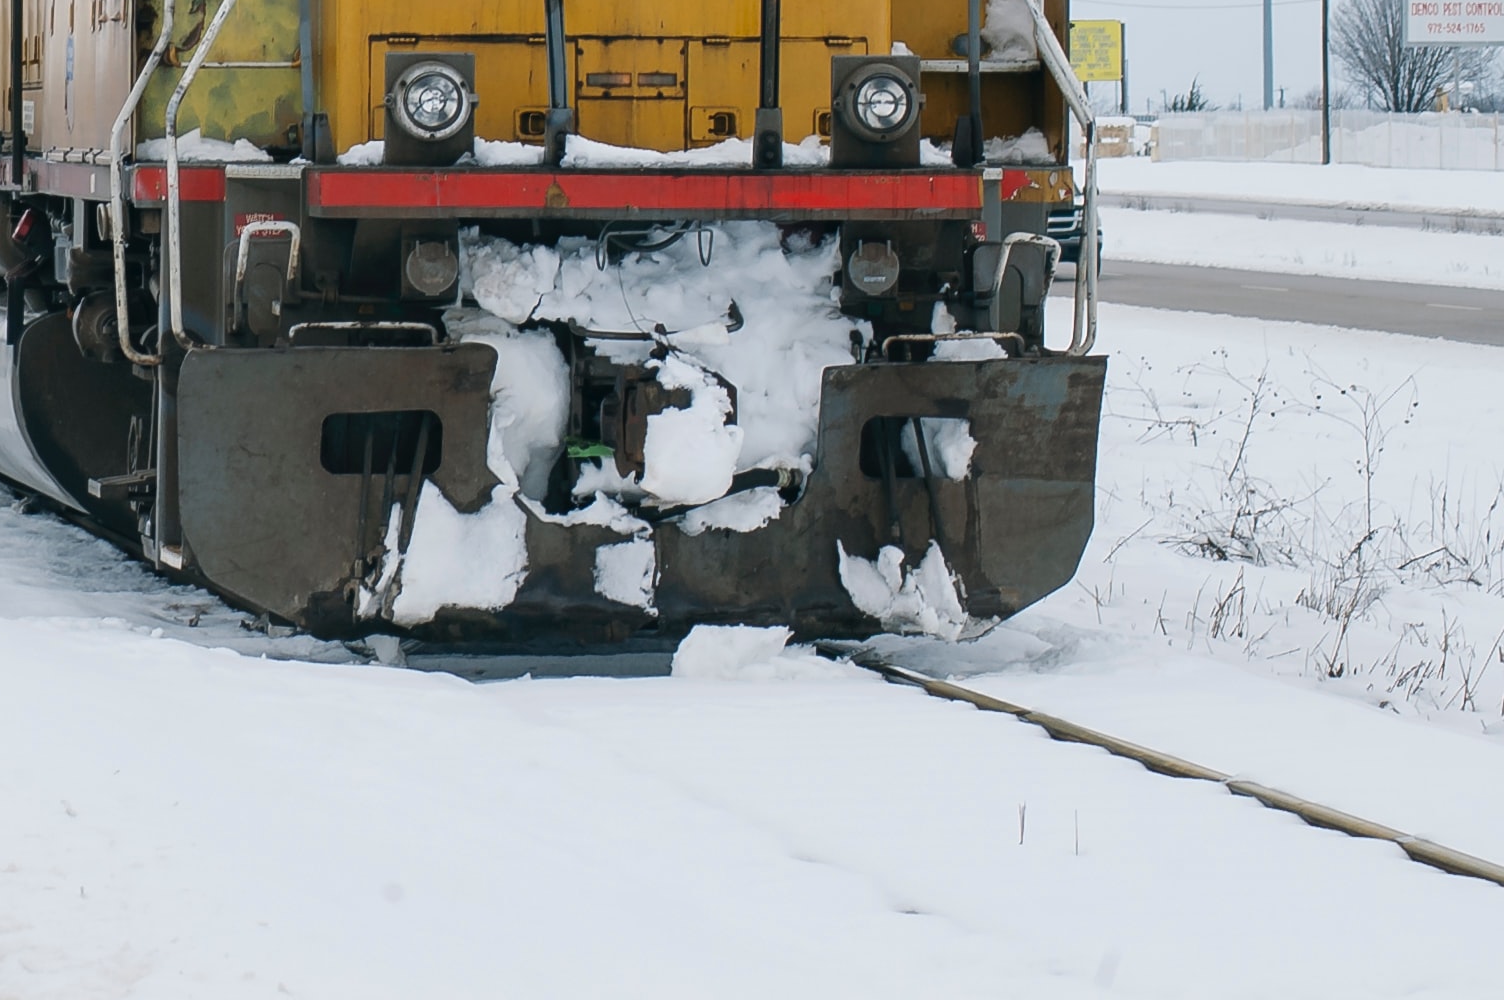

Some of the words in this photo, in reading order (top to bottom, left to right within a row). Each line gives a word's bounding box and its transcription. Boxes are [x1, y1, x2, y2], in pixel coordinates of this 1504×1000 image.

[1443, 2, 1462, 16] PEST
[1465, 2, 1504, 16] CONTROL
[1427, 23, 1486, 34] 972-524-1765
[245, 213, 274, 223] WATCH
